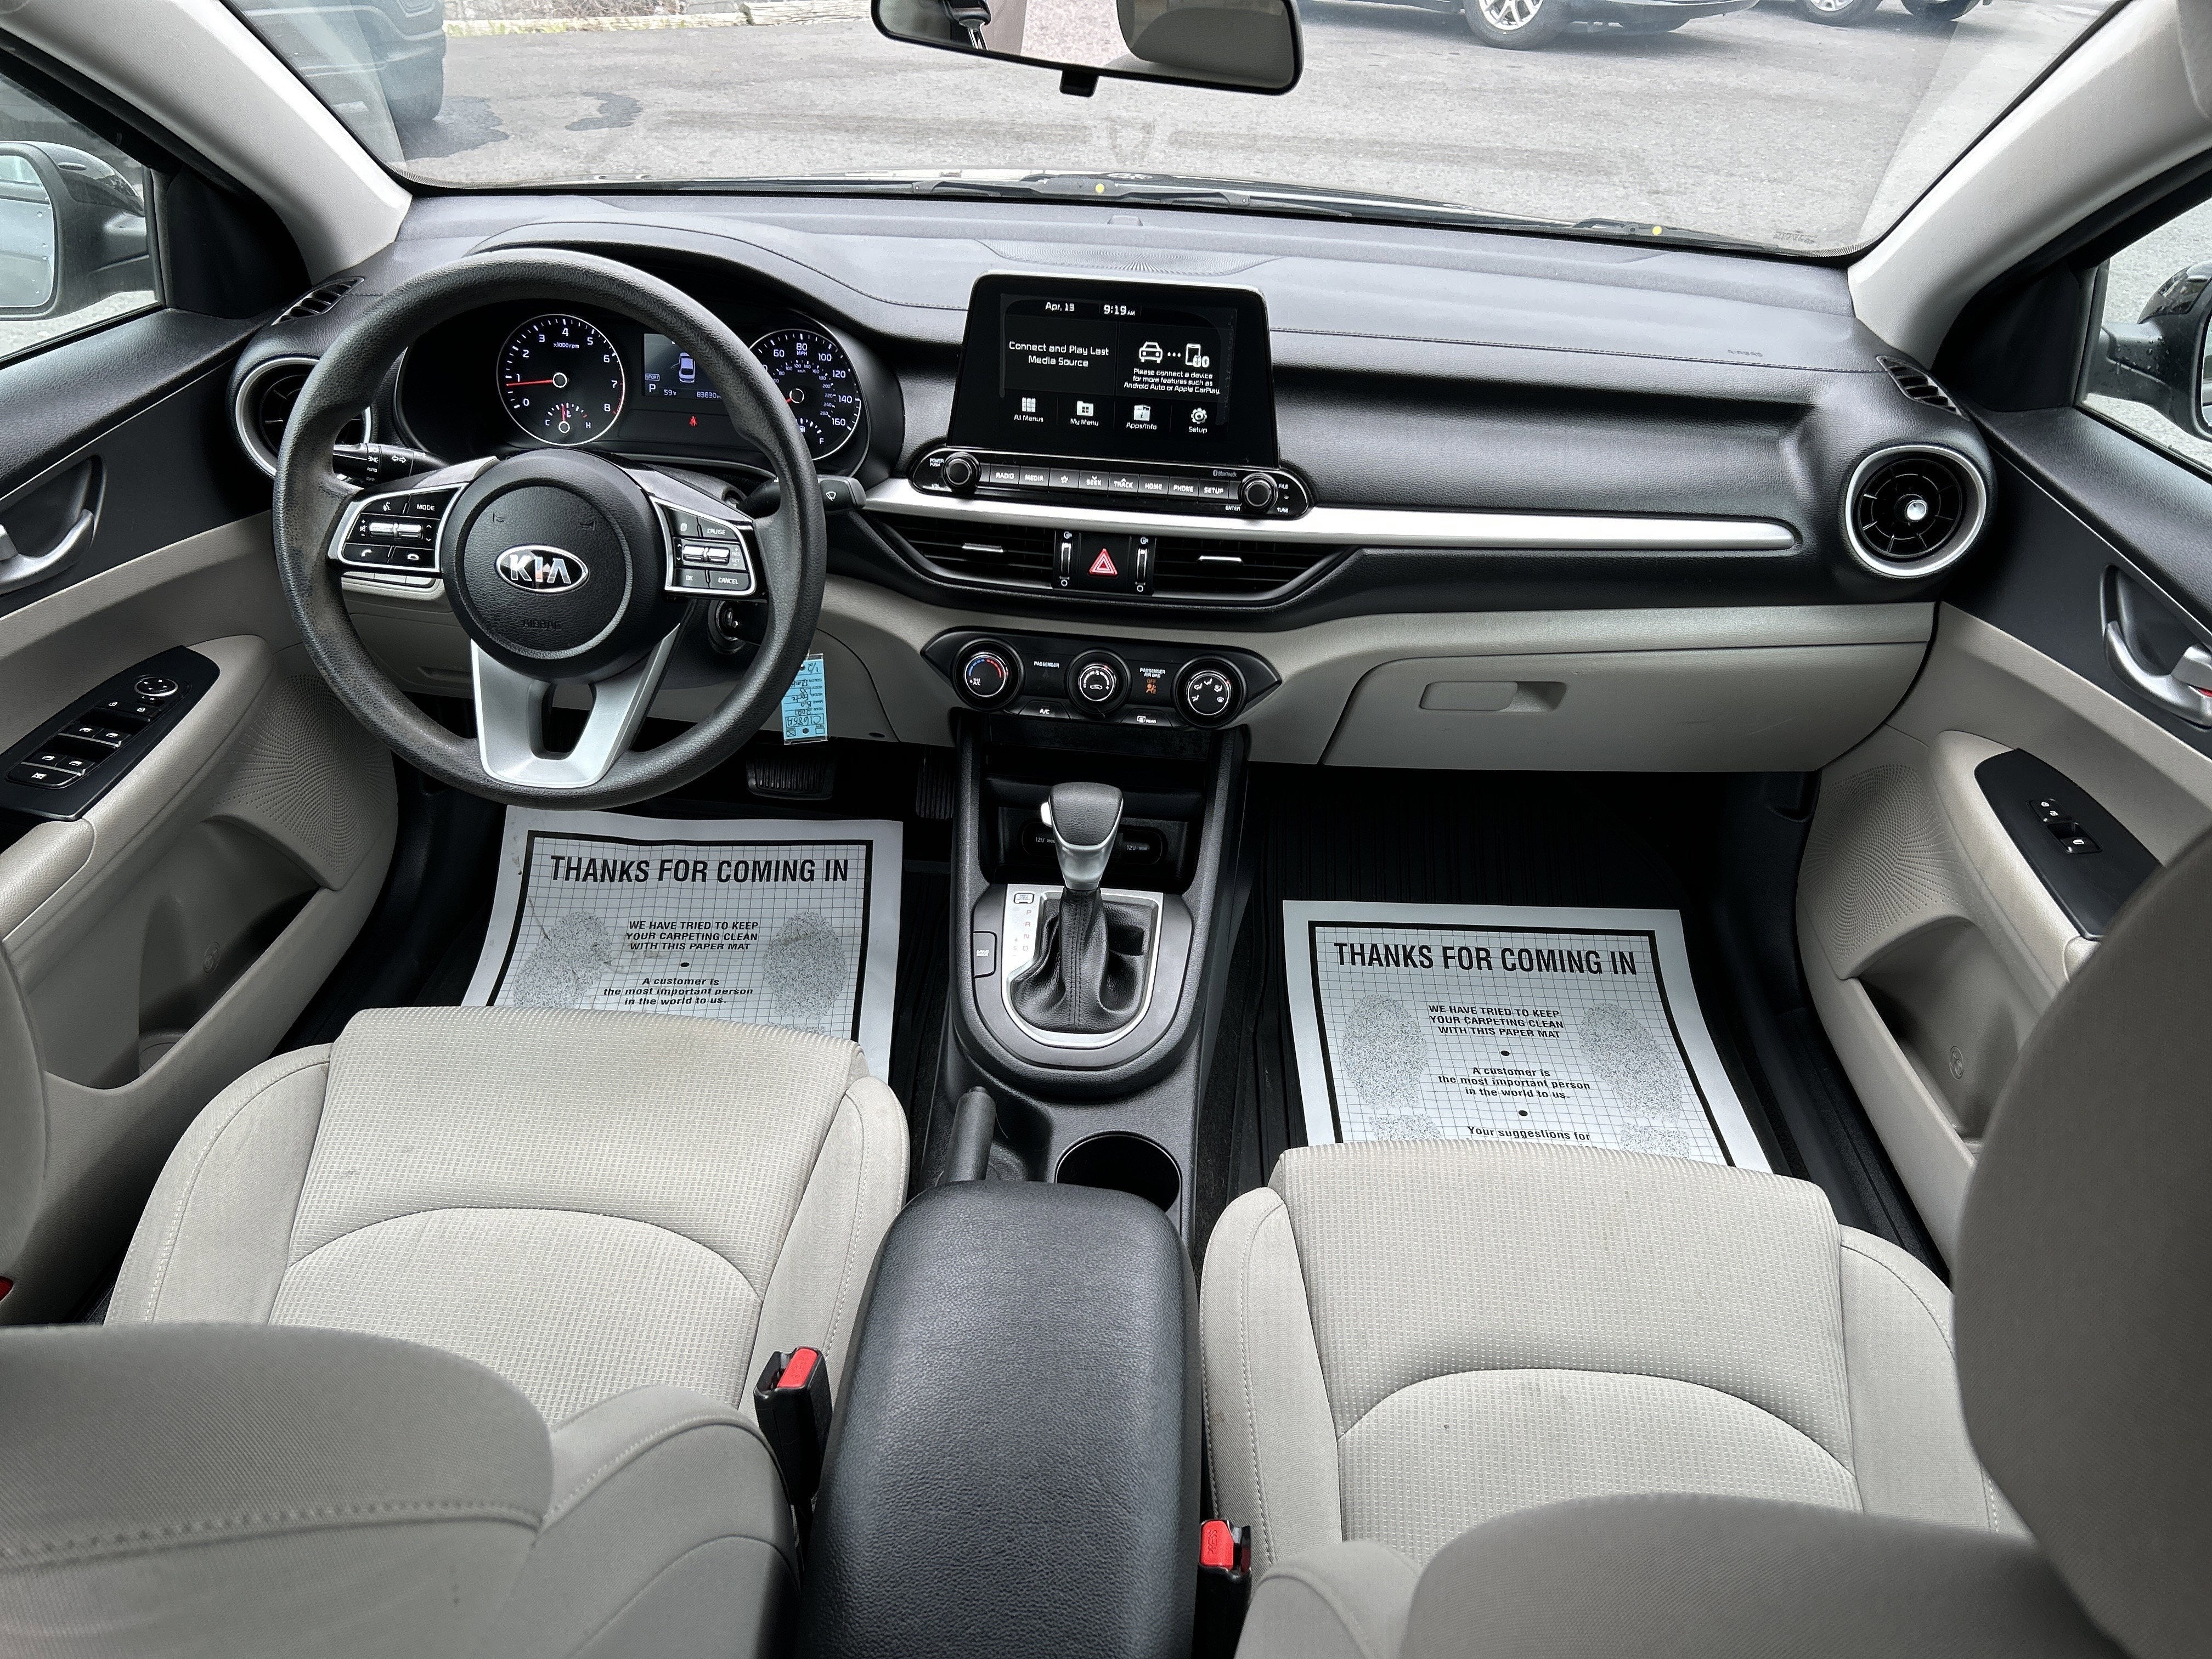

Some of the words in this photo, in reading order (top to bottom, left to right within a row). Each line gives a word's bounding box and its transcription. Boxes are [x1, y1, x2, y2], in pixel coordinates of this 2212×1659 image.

[1045, 302, 1062, 311] Apr.
[1104, 304, 1126, 315] 9:19
[562, 328, 569, 336] 4
[539, 334, 545, 342] 3
[587, 337, 594, 346] 5
[796, 342, 808, 351] 80
[1009, 341, 1047, 352] Connect
[1049, 345, 1066, 353] and
[1069, 345, 1088, 356] Play
[1090, 347, 1109, 356] Last
[523, 349, 529, 358] 2
[774, 349, 785, 357] 60
[819, 353, 832, 362] 100
[603, 354, 610, 363] 6
[1028, 355, 1056, 365] Media
[1058, 357, 1089, 367] Source
[832, 369, 846, 378] 120
[1156, 369, 1183, 377] connect
[516, 374, 520, 382] 1
[611, 380, 618, 388] 7
[648, 383, 656, 392] P
[1124, 381, 1149, 390] Android
[838, 394, 853, 403] 140
[604, 403, 611, 411] 8
[832, 417, 845, 426] 160
[1126, 421, 1157, 430] Apps/Info
[1189, 426, 1207, 434] Setup
[1025, 473, 1044, 482] MEDIA
[1144, 482, 1163, 490] HOME
[1173, 484, 1194, 493] PHONE
[510, 554, 572, 584] KIA
[550, 855, 650, 883] THANKS
[658, 859, 708, 883] FOR
[717, 860, 815, 883] COMING
[824, 860, 849, 882] IN
[629, 921, 646, 929] WE
[732, 922, 759, 930] KEEP
[627, 932, 656, 940] YOUR
[659, 933, 720, 941] CARPETING
[724, 933, 758, 941] CLEAN
[1333, 943, 1434, 969] THANKS
[1442, 946, 1493, 971] FOR
[1501, 948, 1602, 974] COMING
[1610, 951, 1637, 975] IN
[657, 988, 712, 997] important
[1449, 1006, 1477, 1014] HAVE
[1480, 1007, 1511, 1015] TRIED
[1532, 1009, 1559, 1018] KEEP
[1429, 1015, 1460, 1024] YOUR
[1464, 1017, 1525, 1027] CARPETING
[1528, 1020, 1564, 1028] CLEAN
[1470, 1027, 1496, 1035] THIS
[1499, 1028, 1534, 1037] PAPER
[1484, 1068, 1537, 1076] customer
[1460, 1077, 1489, 1085] most
[1492, 1077, 1548, 1087] important
[1551, 1081, 1590, 1090] person
[1465, 1087, 1476, 1095] in
[1479, 1088, 1498, 1096] the
[1501, 1089, 1533, 1097] world
[1466, 1126, 1494, 1136] Your
[1498, 1128, 1571, 1140] suggestions
[1574, 1131, 1590, 1141] for
